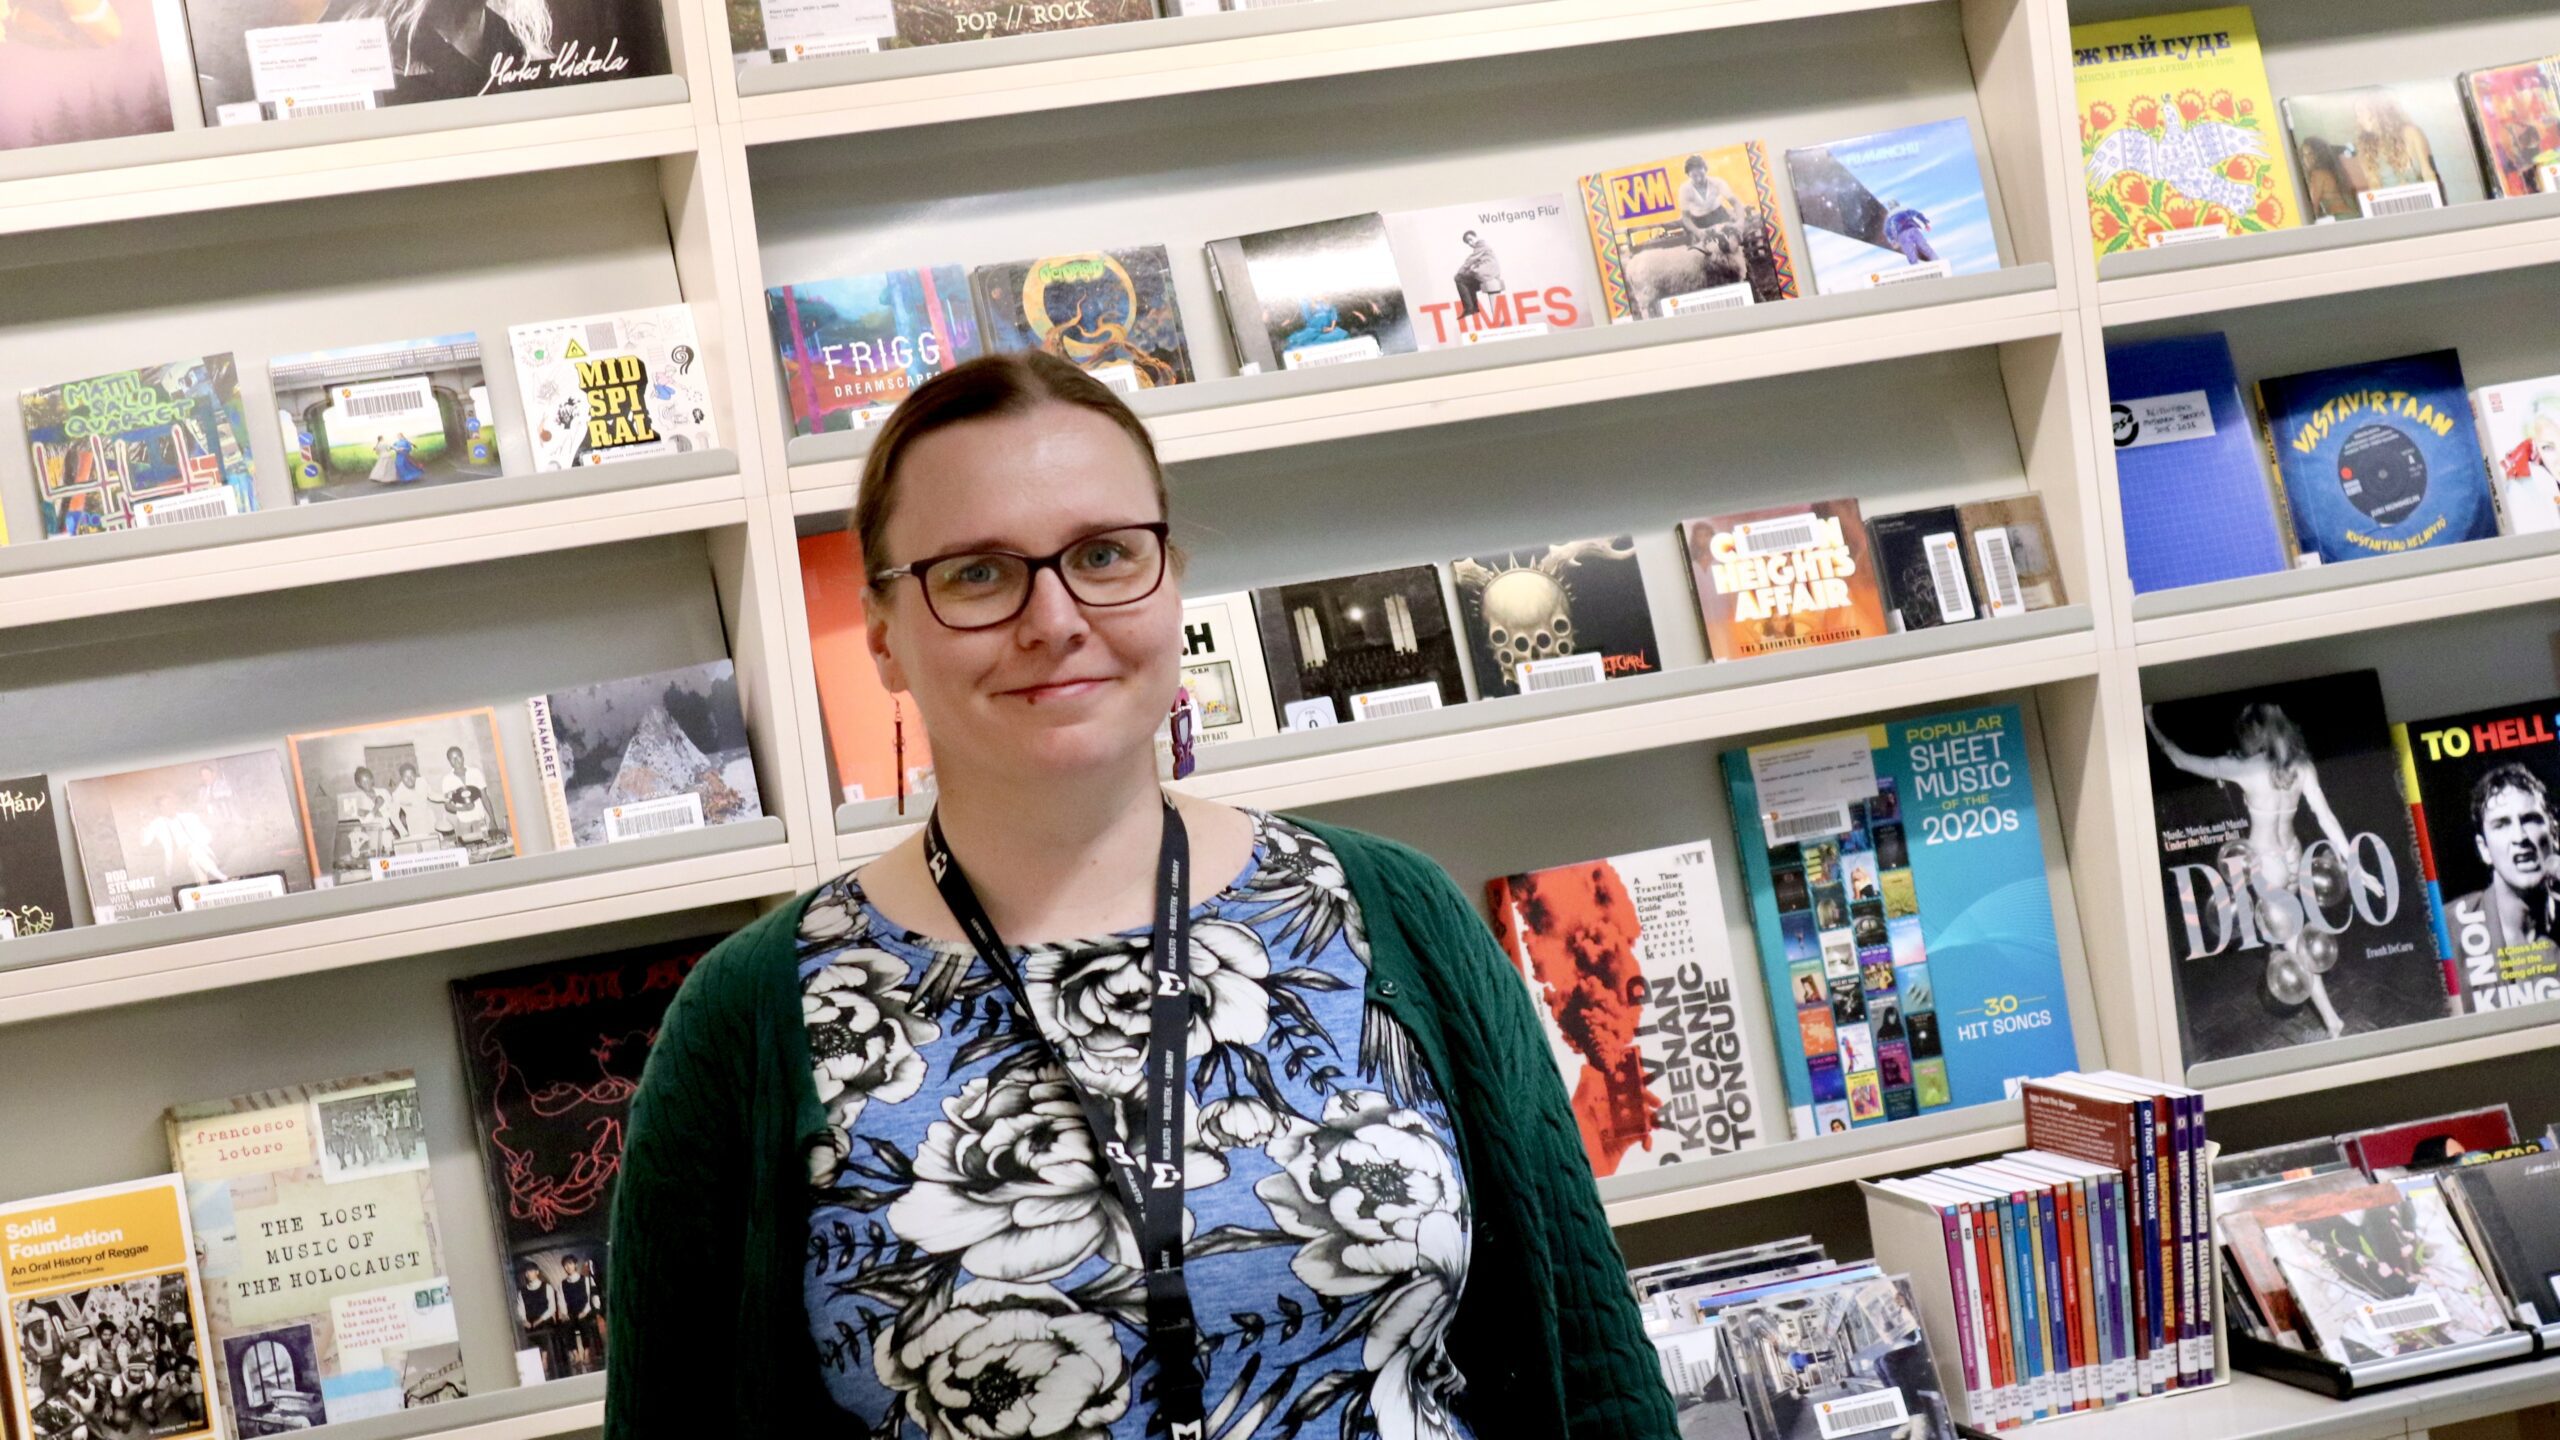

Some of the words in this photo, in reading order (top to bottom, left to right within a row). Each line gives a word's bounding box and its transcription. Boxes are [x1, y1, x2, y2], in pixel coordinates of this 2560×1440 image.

[955, 11, 997, 33] POP
[1032, 0, 1093, 24] ROCK
[2105, 34, 2159, 63] ГАЙ
[2161, 31, 2231, 61] ГУДЕ
[1616, 169, 1674, 216] RAM
[1478, 208, 1536, 225] Wolfgang
[1537, 204, 1560, 218] Flür
[822, 331, 940, 380] FRIGG
[575, 355, 641, 389] MID
[63, 371, 141, 410] MATTI
[89, 387, 156, 417] SALO
[587, 384, 643, 417] SPI
[65, 399, 195, 438] QUARTET
[587, 413, 655, 448] RAL
[2292, 388, 2454, 455] VASTAVIRTAAN
[2345, 530, 2405, 552] KUSTANTAMO
[1712, 546, 1856, 594] HEIGHTS
[1735, 578, 1853, 622] AFFAIR
[1759, 638, 1807, 651] DEFINITIVE
[1810, 630, 1861, 643] COLLECTION
[1212, 731, 1229, 741] RATS
[1906, 714, 2003, 742] POPULAR
[2421, 727, 2470, 760] TO
[2472, 714, 2553, 754] HELL
[1910, 732, 2005, 773] SHEET
[1914, 761, 2011, 801] MUSIC
[1941, 798, 1961, 811] OF
[1963, 793, 1989, 807] THE
[1923, 805, 2019, 845] 2020s
[2162, 829, 2185, 840] Music,
[2212, 821, 2225, 832] and
[2164, 840, 2187, 851] Under
[2187, 838, 2199, 848] the
[2200, 834, 2224, 845] Mirror
[2225, 829, 2240, 841] Ball
[105, 869, 127, 884] ROD
[108, 876, 156, 895] STEWART
[1172, 859, 1180, 889] LIBRARY
[1635, 881, 1684, 894] Travelling
[1658, 872, 1681, 880] Time-
[110, 895, 131, 904] WITH
[114, 902, 135, 913] OOLS
[136, 895, 172, 909] HOLLAND
[1636, 890, 1685, 904] Evangelist's
[1638, 903, 1661, 913] Guide
[2168, 832, 2400, 961] DISCO
[1169, 896, 1179, 933] BIBLIOTEK
[1639, 914, 1657, 922] Late
[1641, 918, 1690, 931] Century
[1168, 940, 1177, 970] KIRJASTO
[1644, 936, 1693, 954] ground
[1646, 946, 1695, 960] Music
[2366, 945, 2387, 959] Frank
[2455, 900, 2498, 986] JON
[2497, 948, 2505, 958] A
[2505, 946, 2530, 956] Class
[2499, 957, 2526, 969] Inside
[2527, 955, 2542, 963] the
[2501, 969, 2526, 980] Gang
[2527, 966, 2536, 976] of
[2537, 963, 2558, 974] Four
[1984, 995, 2018, 1017] 30
[1958, 1021, 1989, 1042] HIT
[1992, 1009, 2052, 1034] SONGS
[1165, 1049, 1174, 1079] LIBRARY
[1651, 976, 1704, 1152] KEENAN
[1708, 977, 1756, 1150] TONGUE
[1163, 1086, 1172, 1120] BIBLIOTEK
[2144, 1109, 2151, 1125] on
[196, 1118, 296, 1145] francesco
[1162, 1127, 1172, 1160] KIRJASTO
[2146, 1127, 2155, 1157] track
[218, 1142, 284, 1162] lotoro
[1123, 1166, 1143, 1204] KIRJASTO
[2147, 1172, 2156, 1220] Ultravox
[6, 1216, 57, 1241] Solid
[261, 1216, 304, 1238] THE
[320, 1203, 377, 1227] LOST
[8, 1228, 123, 1261] Foundation
[11, 1265, 26, 1276] An
[29, 1258, 51, 1272] Oral
[53, 1253, 92, 1269] History
[95, 1251, 106, 1261] of
[108, 1243, 149, 1259] Reggae
[266, 1238, 338, 1265] MUSIC
[348, 1231, 374, 1250] OF
[238, 1277, 281, 1298] THE
[289, 1251, 421, 1289] HOLOCAUST
[338, 1332, 352, 1340] the
[392, 1322, 406, 1330] the
